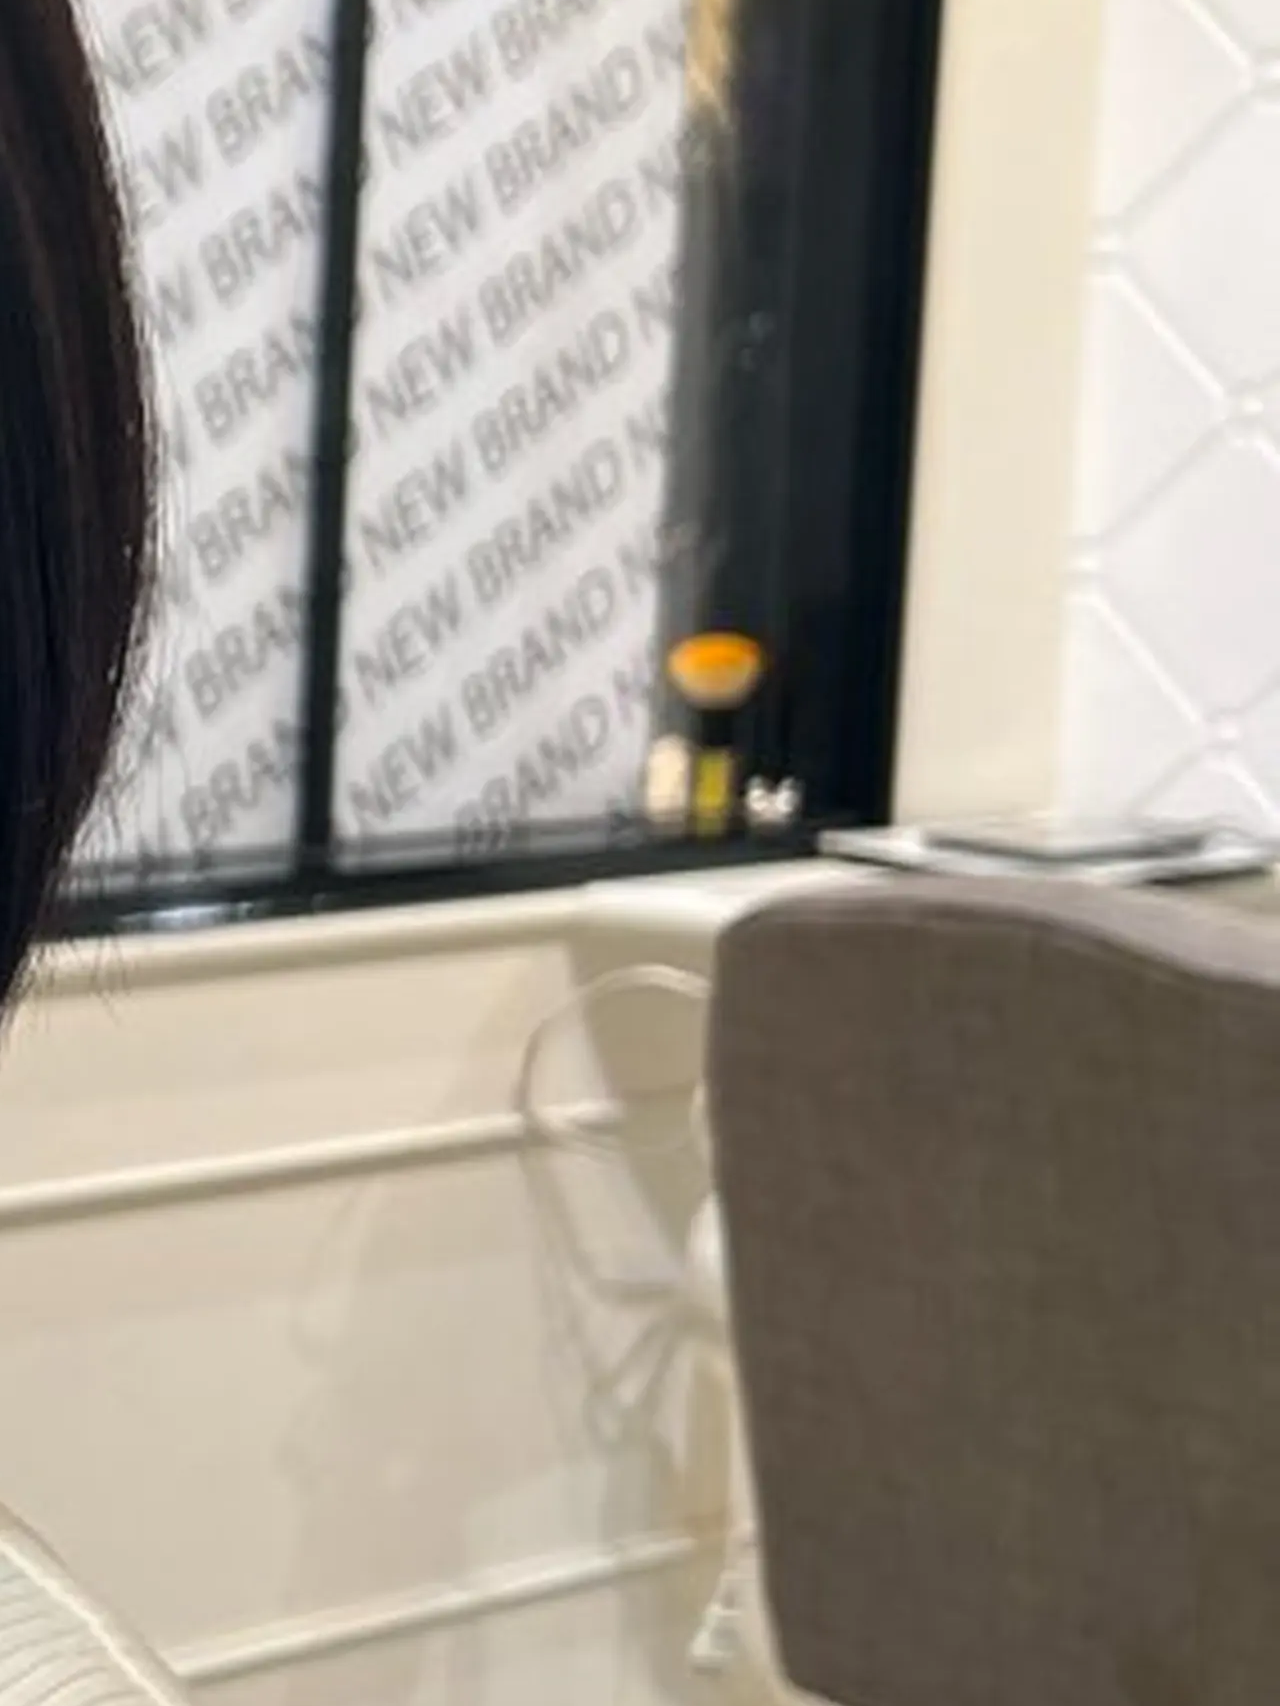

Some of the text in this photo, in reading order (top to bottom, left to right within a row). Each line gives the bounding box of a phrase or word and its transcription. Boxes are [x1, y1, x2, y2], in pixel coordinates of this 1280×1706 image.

[371, 170, 480, 307] NEW
[484, 45, 647, 217] BRAND
[375, 27, 490, 170] NEW
[365, 301, 472, 442] NEW
[478, 176, 636, 348] BRAND
[353, 568, 461, 707] NEW
[466, 436, 623, 614] BRAND
[359, 432, 466, 577] NEW
[472, 309, 630, 481] BRAND
[347, 698, 456, 833] NEW
[461, 564, 616, 743] BRAND
[454, 693, 610, 856] BRAND
